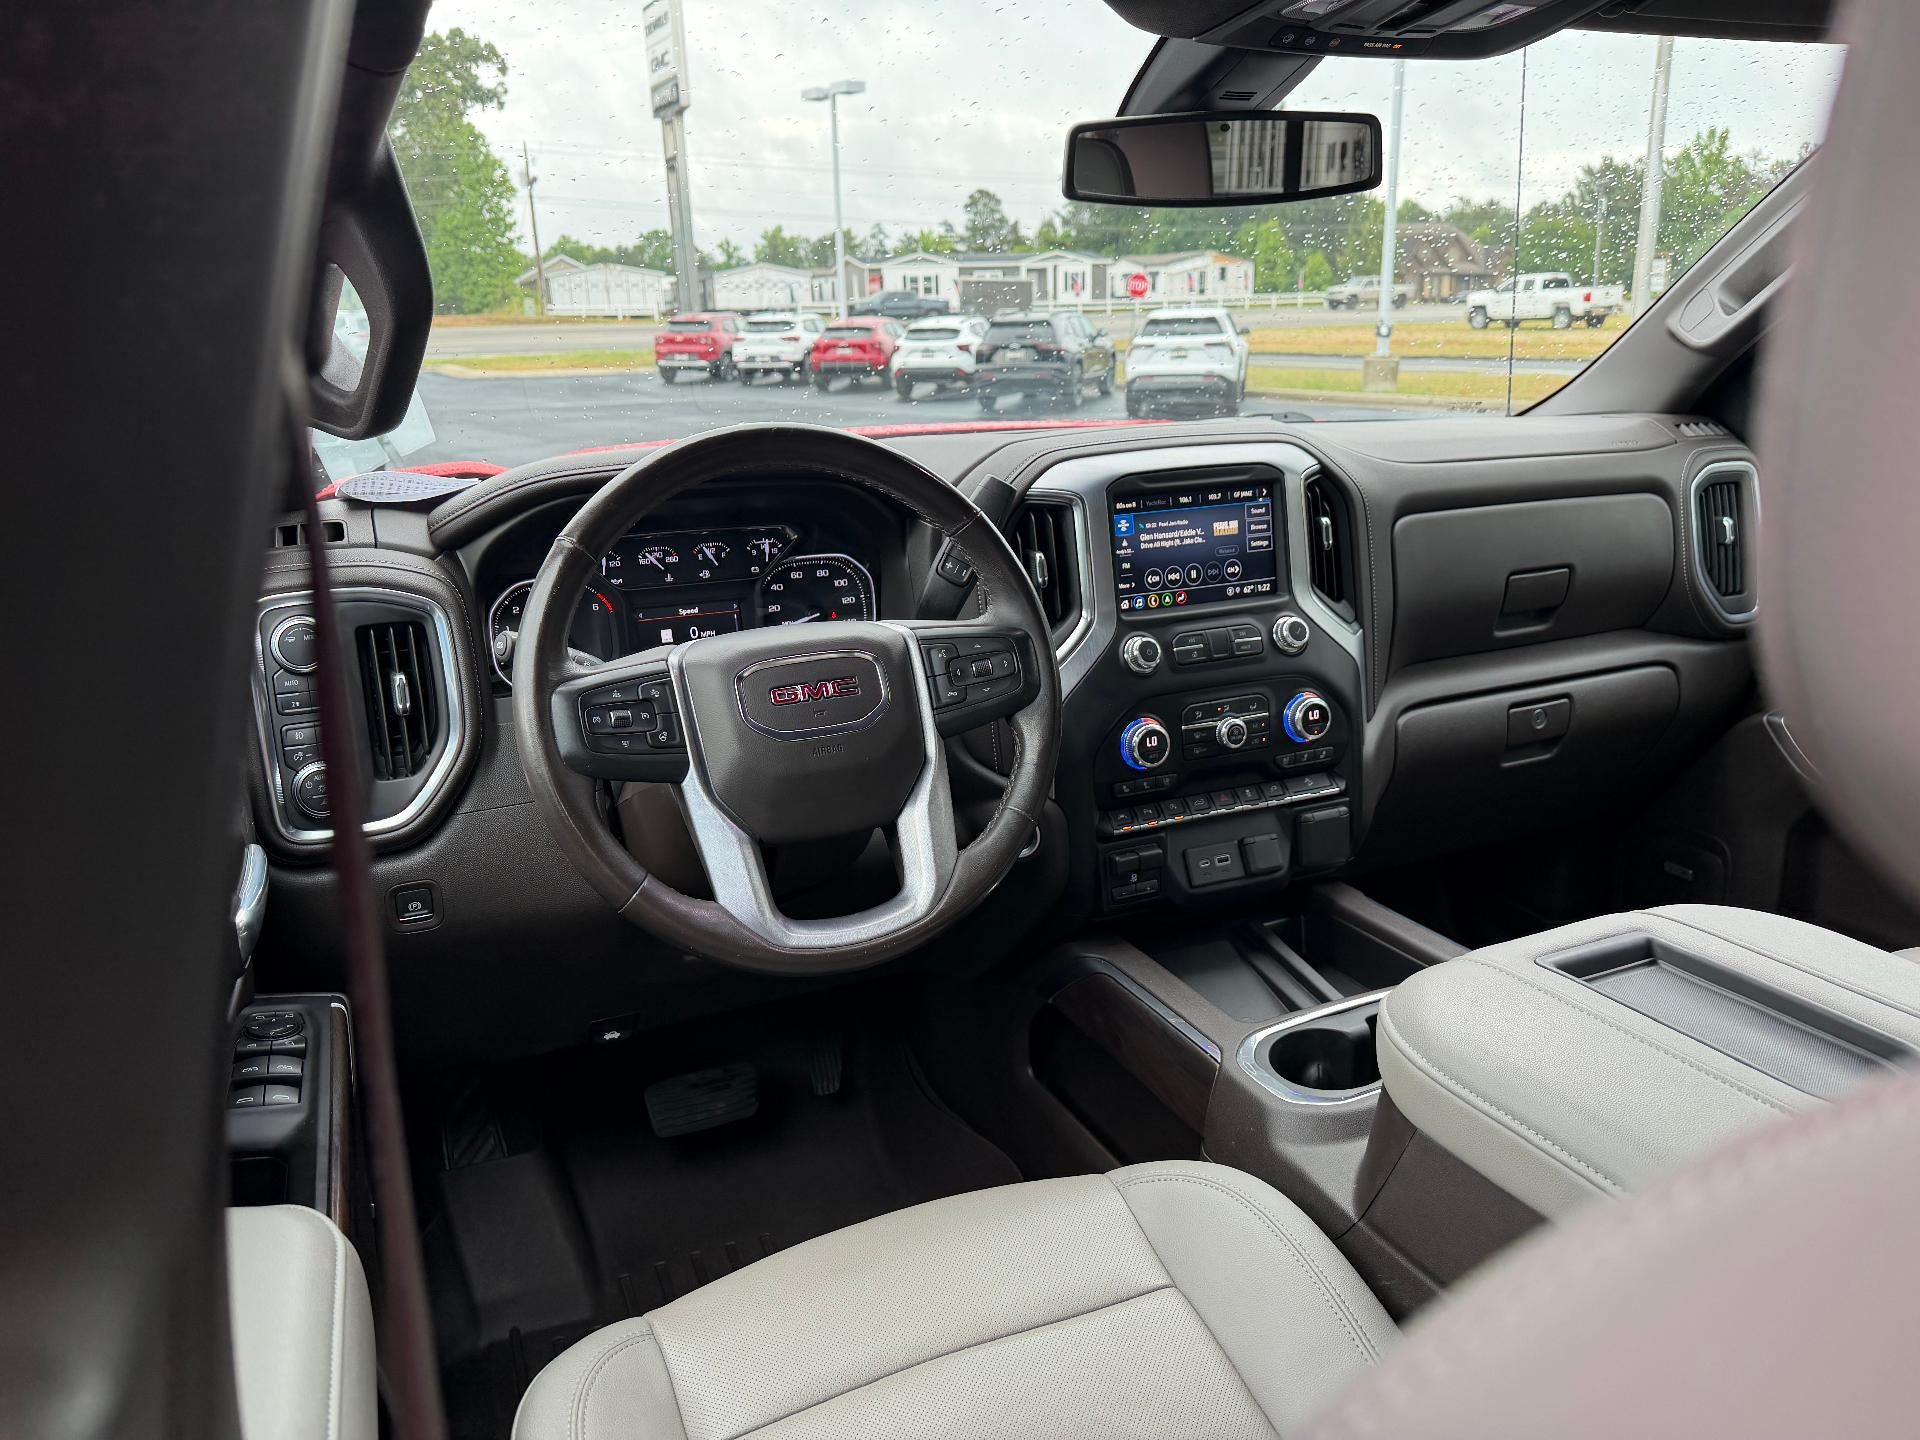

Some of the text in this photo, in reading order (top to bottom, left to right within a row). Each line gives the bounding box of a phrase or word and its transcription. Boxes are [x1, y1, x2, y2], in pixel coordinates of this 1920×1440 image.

[1178, 495, 1192, 504] 106.1
[1140, 534, 1154, 542] Glen
[1140, 542, 1154, 550] Drive
[1160, 540, 1174, 548] Night
[608, 560, 621, 568] 120
[790, 571, 803, 579] 60
[816, 569, 829, 577] 80
[770, 583, 784, 591] 40
[833, 578, 848, 587] 100
[841, 596, 856, 605] 120
[512, 606, 520, 614] 2
[592, 603, 599, 611] 6
[678, 606, 699, 617] Speed
[768, 604, 780, 613] 20
[690, 627, 716, 639] 0 MPH
[770, 675, 861, 706] GMC
[1308, 710, 1320, 720] LO
[1146, 736, 1158, 747] LO
